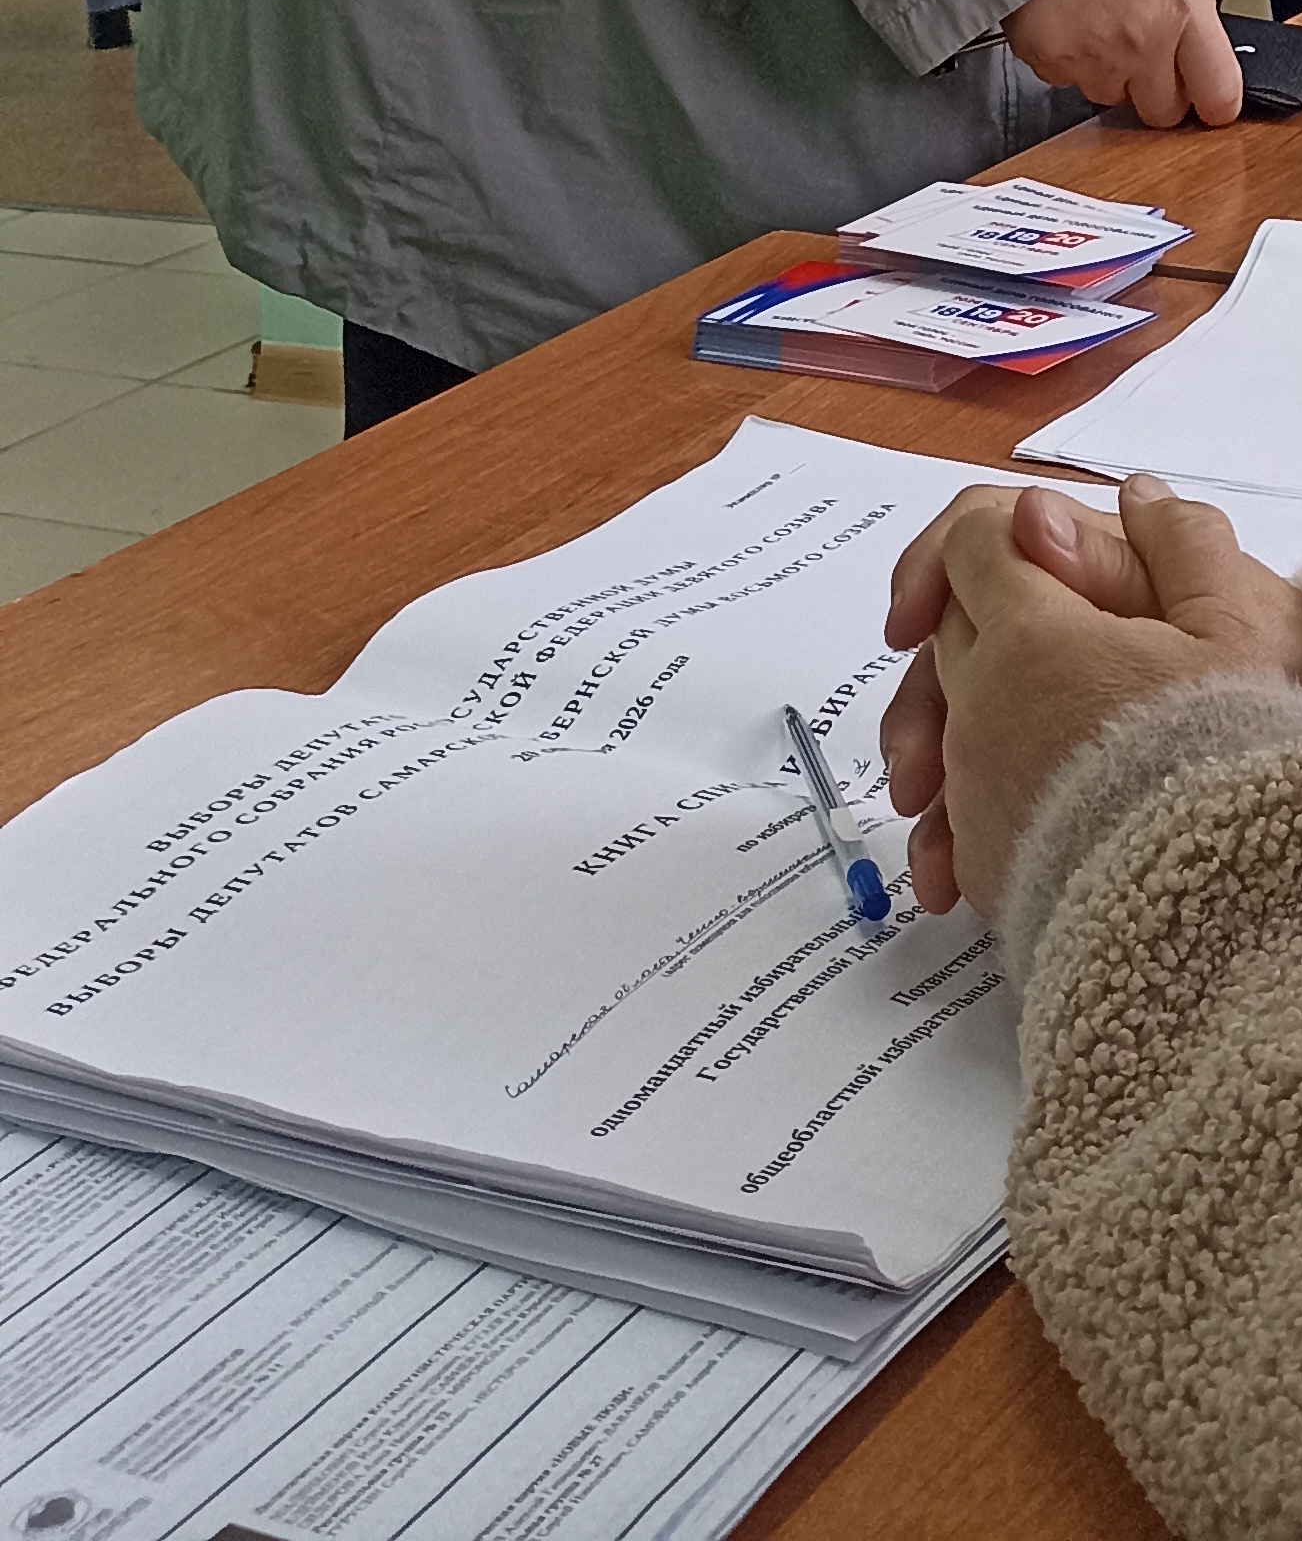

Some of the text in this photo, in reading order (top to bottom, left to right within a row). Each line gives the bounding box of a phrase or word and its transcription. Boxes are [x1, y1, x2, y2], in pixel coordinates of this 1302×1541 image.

[972, 228, 1081, 246] 18 19 20
[929, 303, 1051, 324] 18 19 20
[147, 772, 272, 853] ВЫБОРЫ
[449, 583, 634, 720] СУДАРСТВЕННОЙ
[235, 737, 380, 826] СОБРАНИЯ
[535, 589, 664, 664] ФЕДЕРАЦИИ
[661, 544, 764, 593] ДЕВЯТОГО
[762, 497, 840, 544] СОЗЫВА
[609, 695, 655, 741] 2026
[650, 653, 692, 692] года
[46, 926, 188, 1016] ВЫБОРЫ
[188, 803, 359, 924] ДЕПУТАТОВ
[653, 601, 721, 628] ДУМЫ
[716, 552, 824, 603] ВОСЬМОГО
[822, 502, 898, 551] СОЗЫВА
[572, 815, 681, 876] КНИГА
[737, 838, 759, 853] по
[590, 1003, 743, 1138] одномандатный
[739, 902, 864, 1005] избирательный
[695, 924, 902, 1085] Государственной Думы
[889, 930, 997, 1008] Похвистневс
[740, 971, 1006, 1195] общеобластной избирательный
